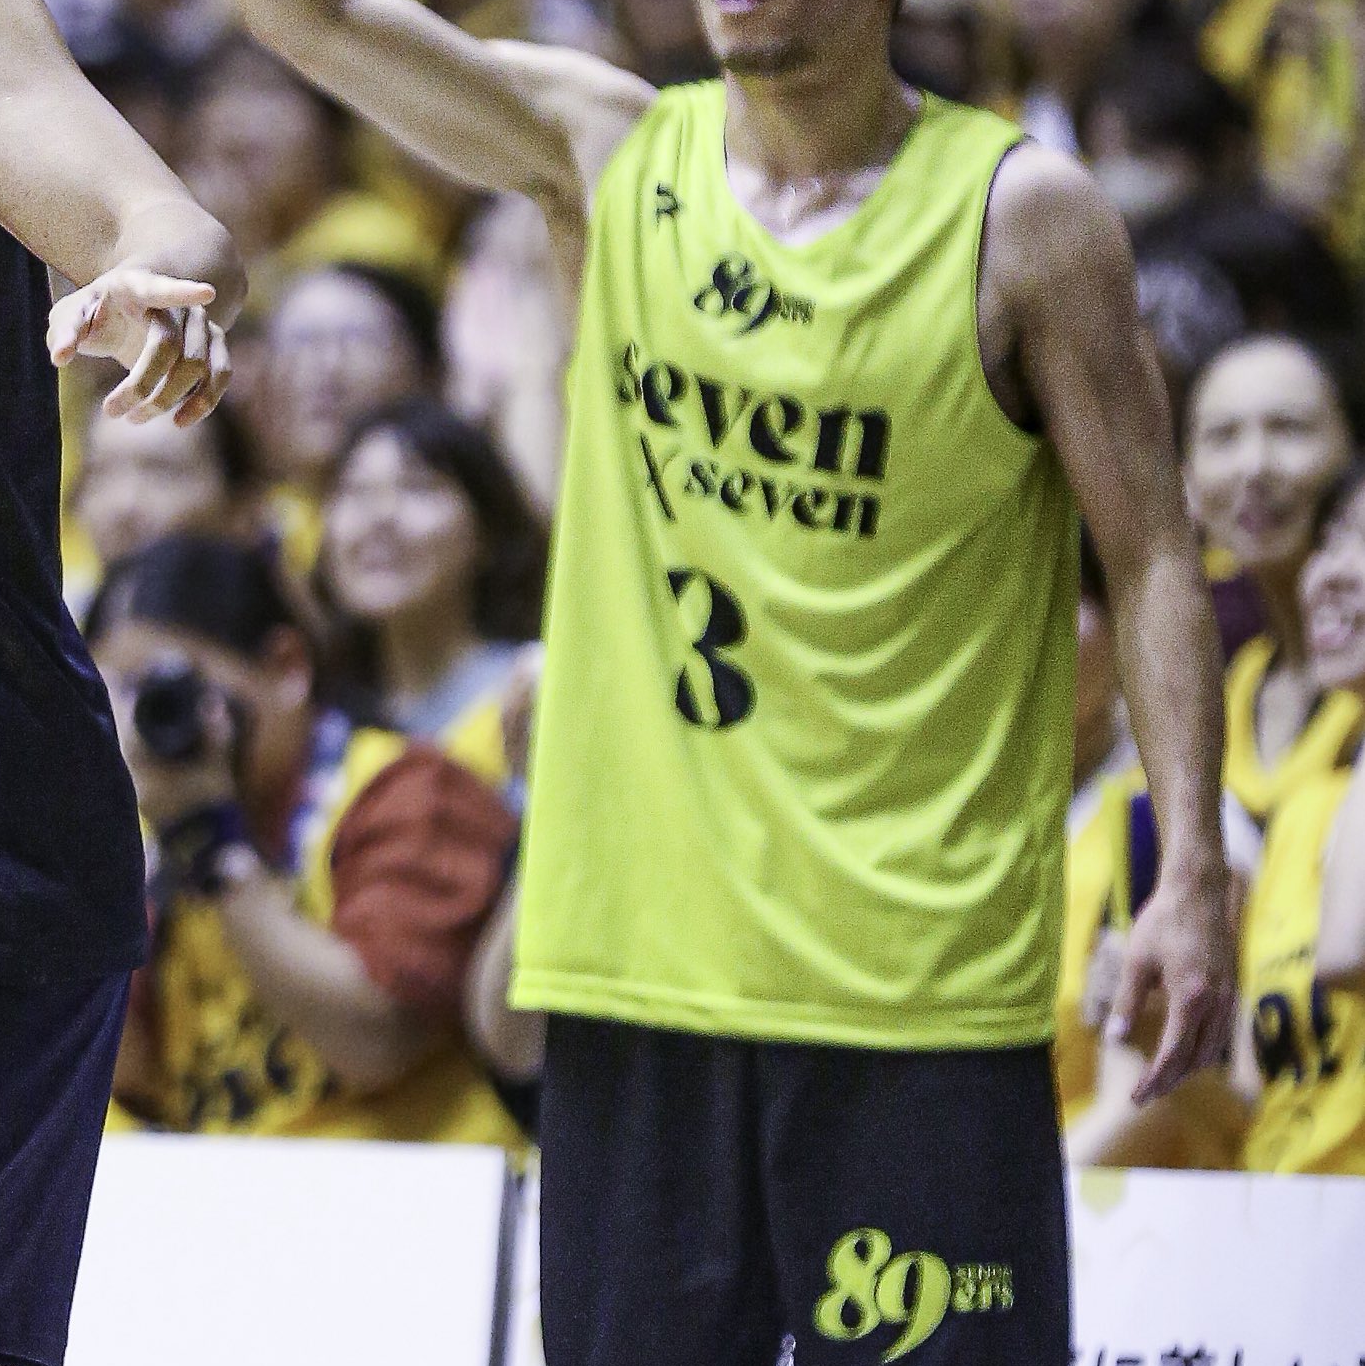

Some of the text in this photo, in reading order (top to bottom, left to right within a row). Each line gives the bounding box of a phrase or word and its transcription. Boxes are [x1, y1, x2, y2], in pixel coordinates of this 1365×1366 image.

[615, 341, 891, 482] seven
[683, 460, 881, 539] seven
[666, 566, 758, 730] 3
